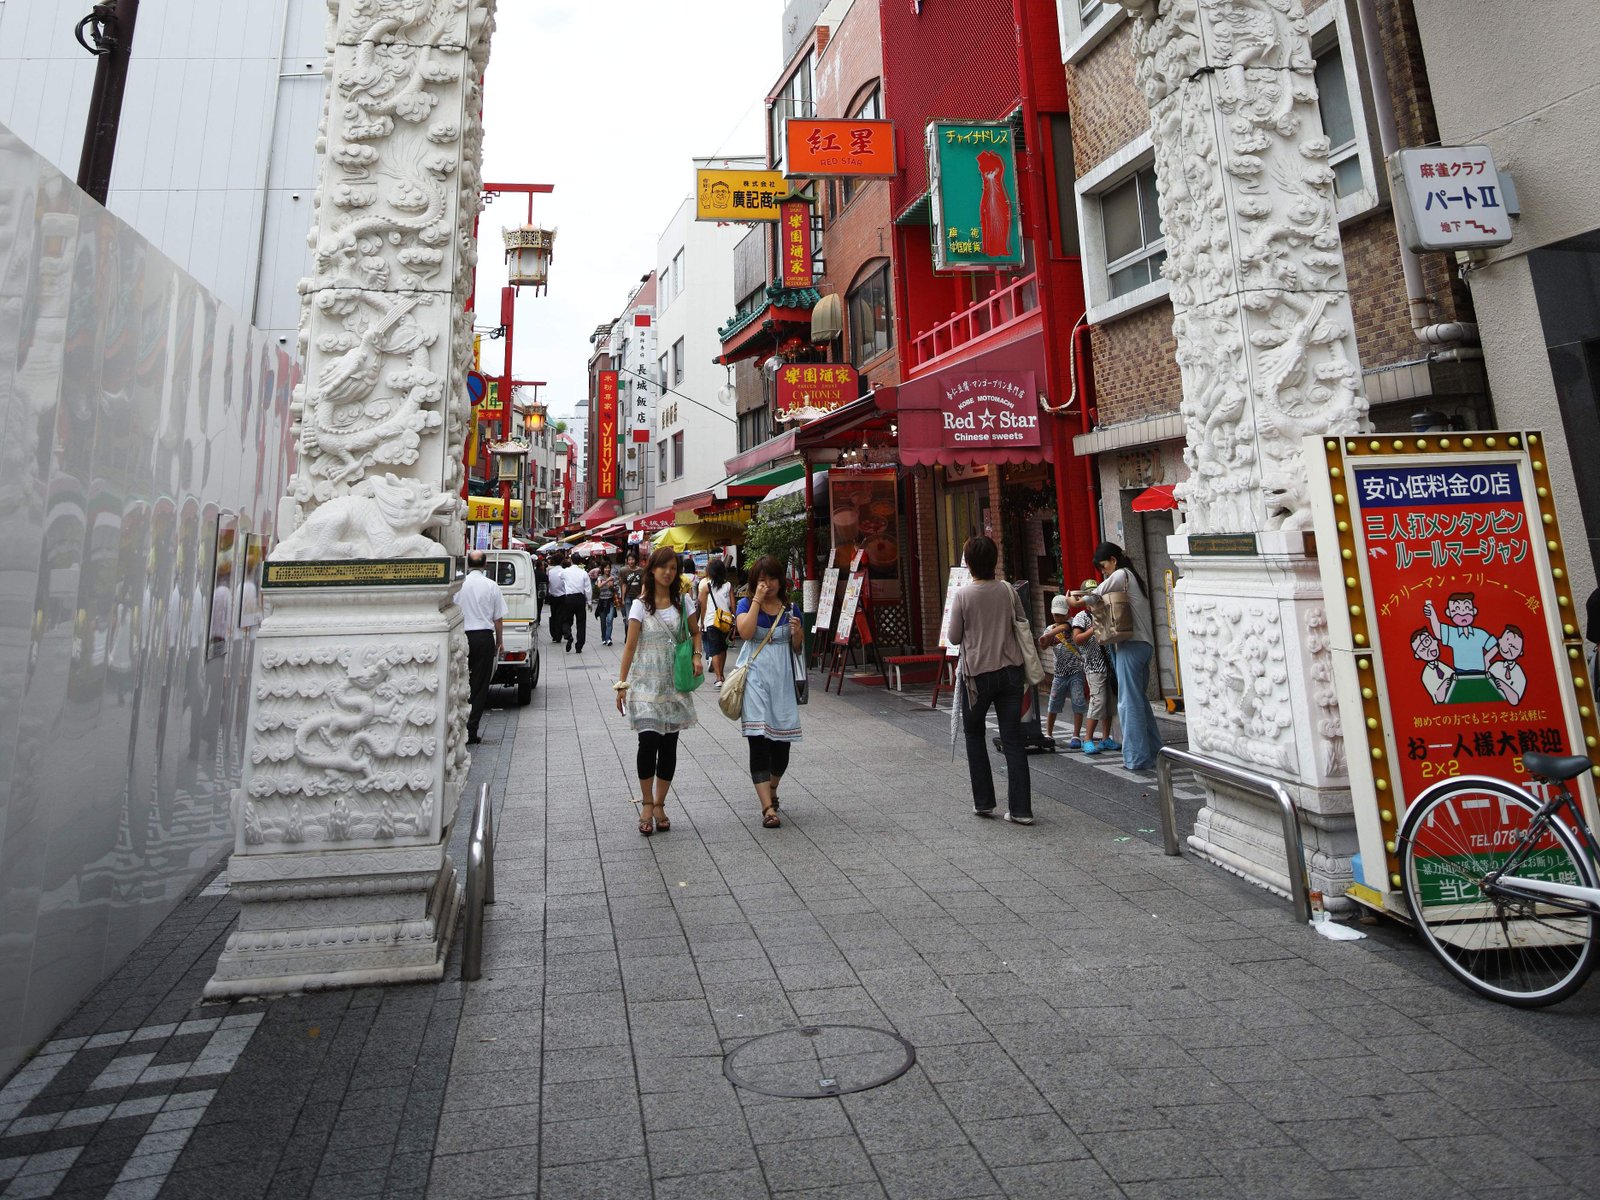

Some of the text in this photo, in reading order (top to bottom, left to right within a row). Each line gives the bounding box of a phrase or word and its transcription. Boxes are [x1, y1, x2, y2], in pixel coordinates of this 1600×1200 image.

[806, 128, 875, 155] 紅星
[820, 156, 863, 167] RED STAR
[1420, 160, 1487, 179] 麻雀クラブ
[743, 180, 776, 188] 株式会社
[1440, 221, 1461, 232] 地下
[958, 395, 1015, 410] KOBE MOTOMACHI
[942, 411, 1037, 429] Red Star
[954, 432, 1024, 441] Chinese sweets
[1363, 472, 1511, 501] 安心低料金の店
[1366, 509, 1523, 540] 三人打メンタンピン
[1395, 537, 1528, 569] ルールマージャン
[1413, 710, 1547, 728] 初めての方でもどうぞお気軽に
